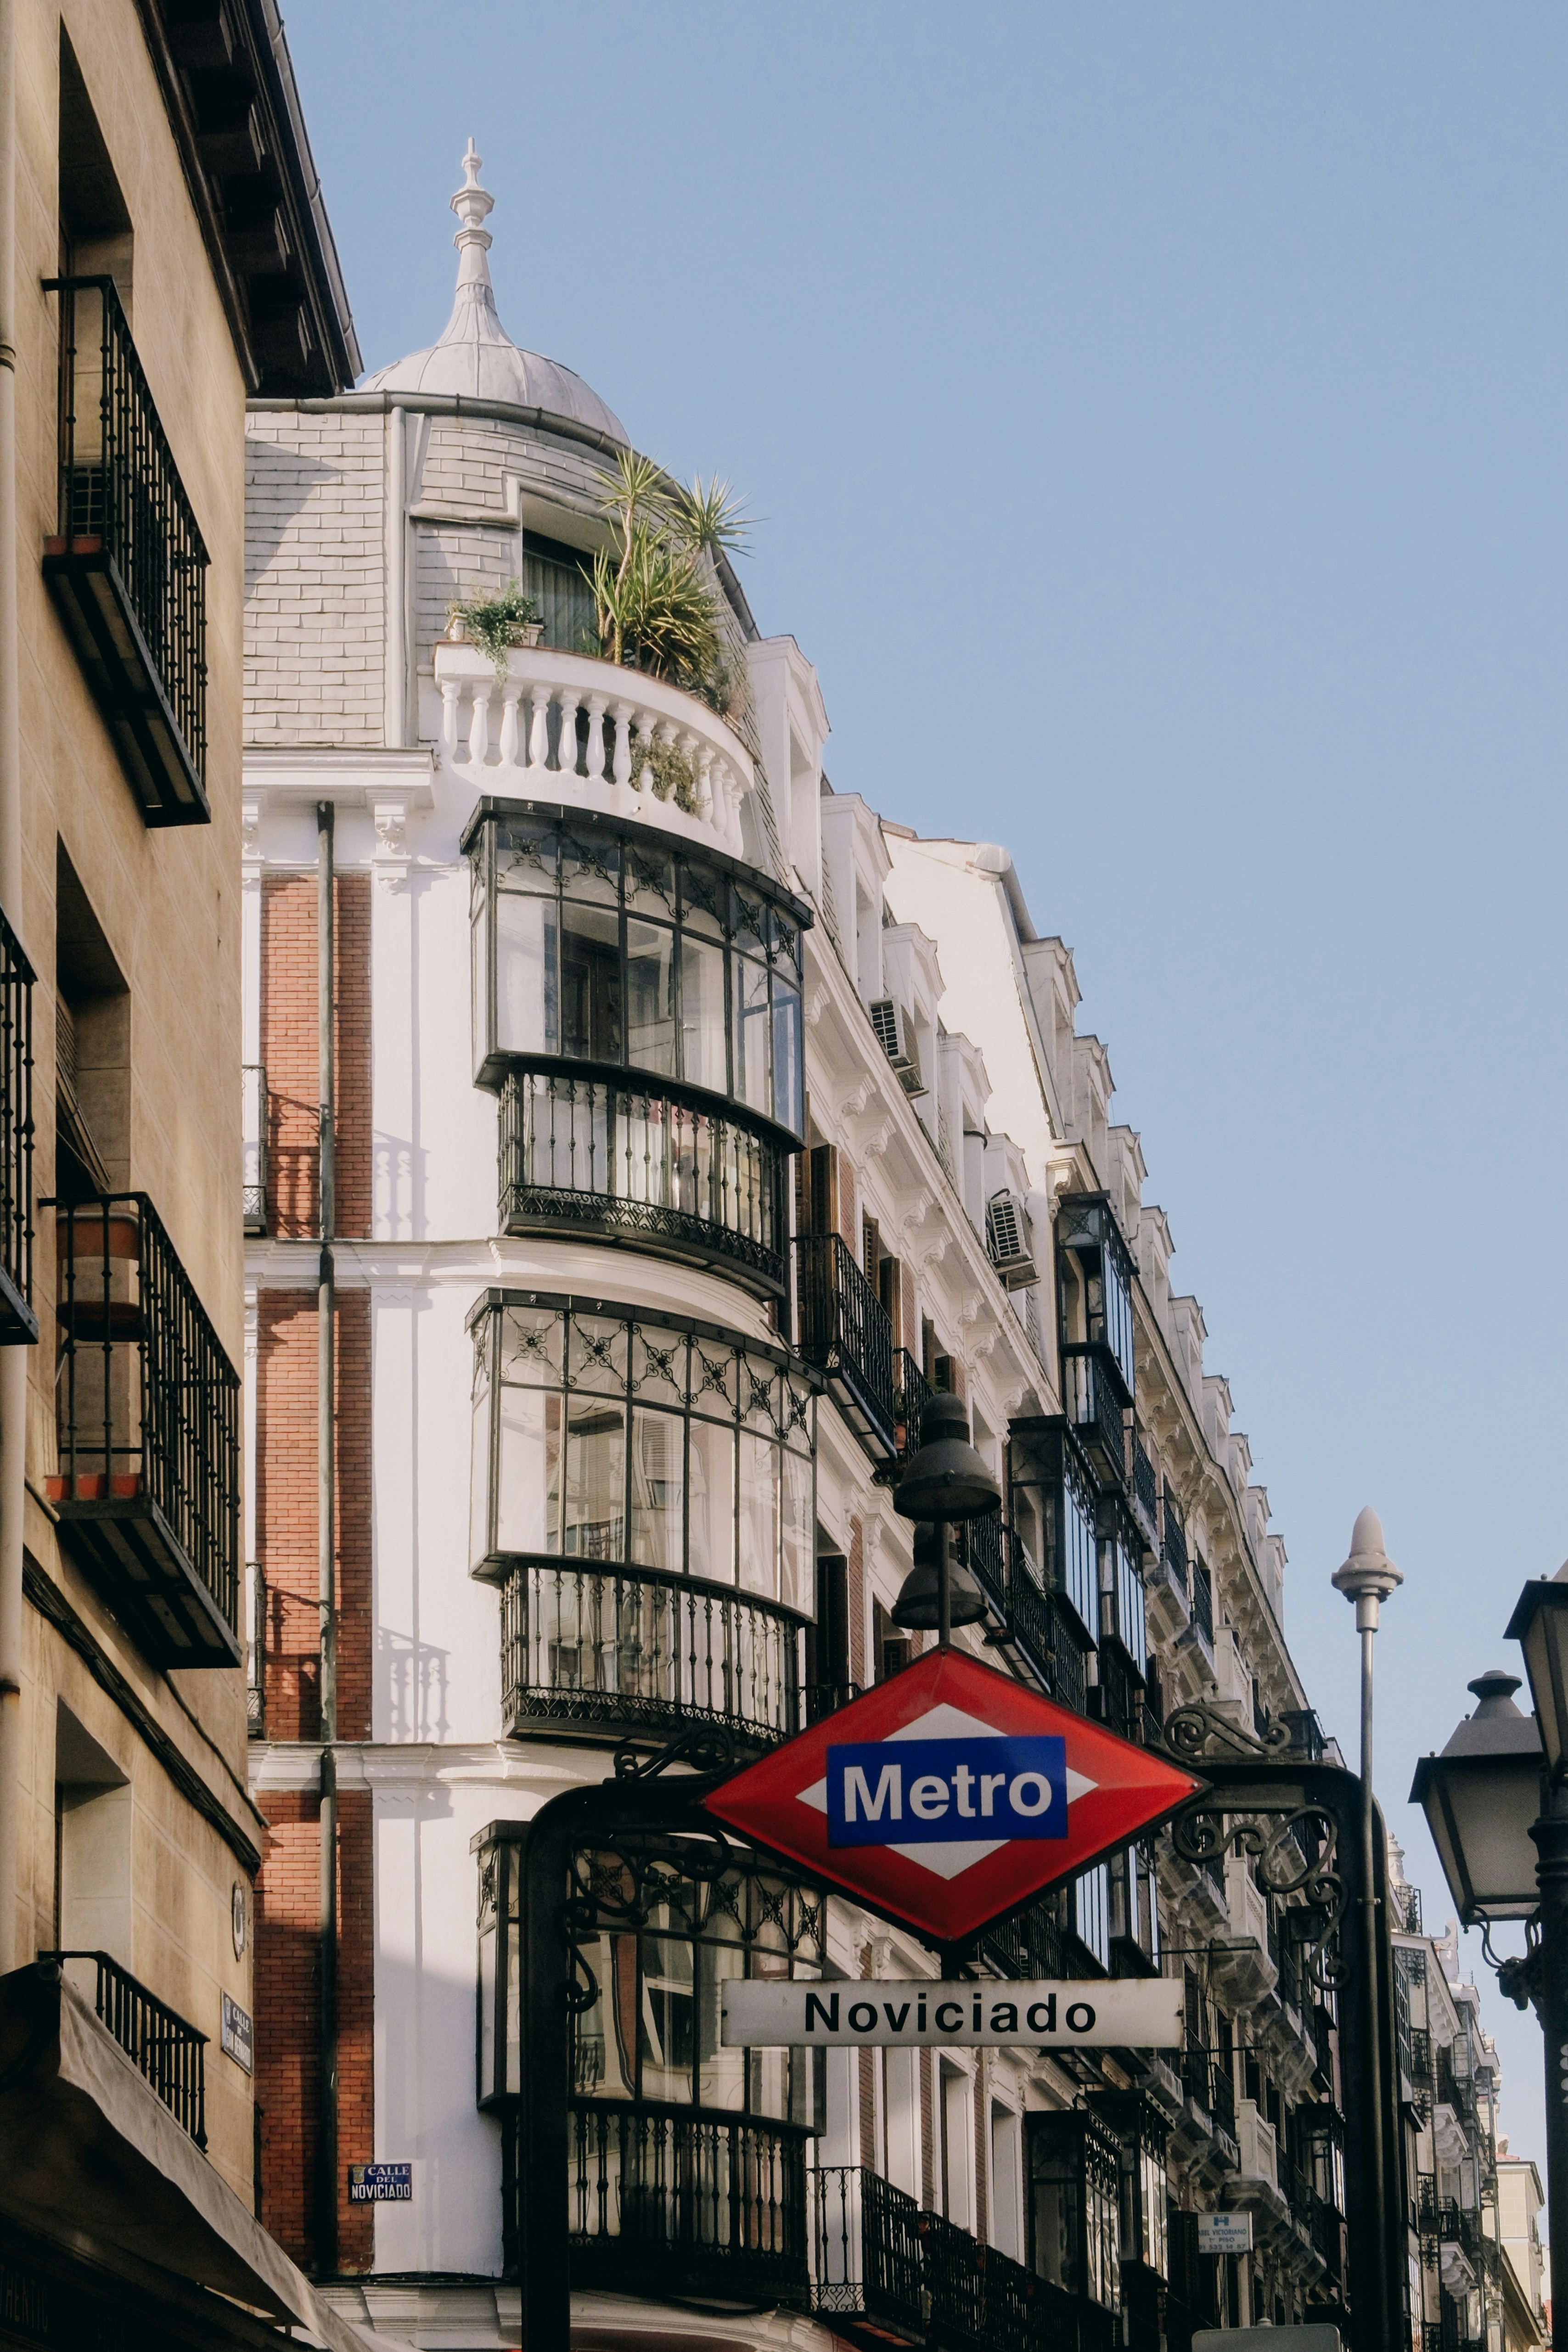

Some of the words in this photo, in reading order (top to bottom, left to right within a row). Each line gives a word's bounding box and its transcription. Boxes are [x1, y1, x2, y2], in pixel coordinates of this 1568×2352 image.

[843, 1764, 1053, 1823] Metro
[233, 2007, 249, 2033] CALLE
[804, 1993, 1096, 2034] Noviciado
[368, 2166, 409, 2176] CALLE
[352, 2184, 410, 2199] NOVICIADO
